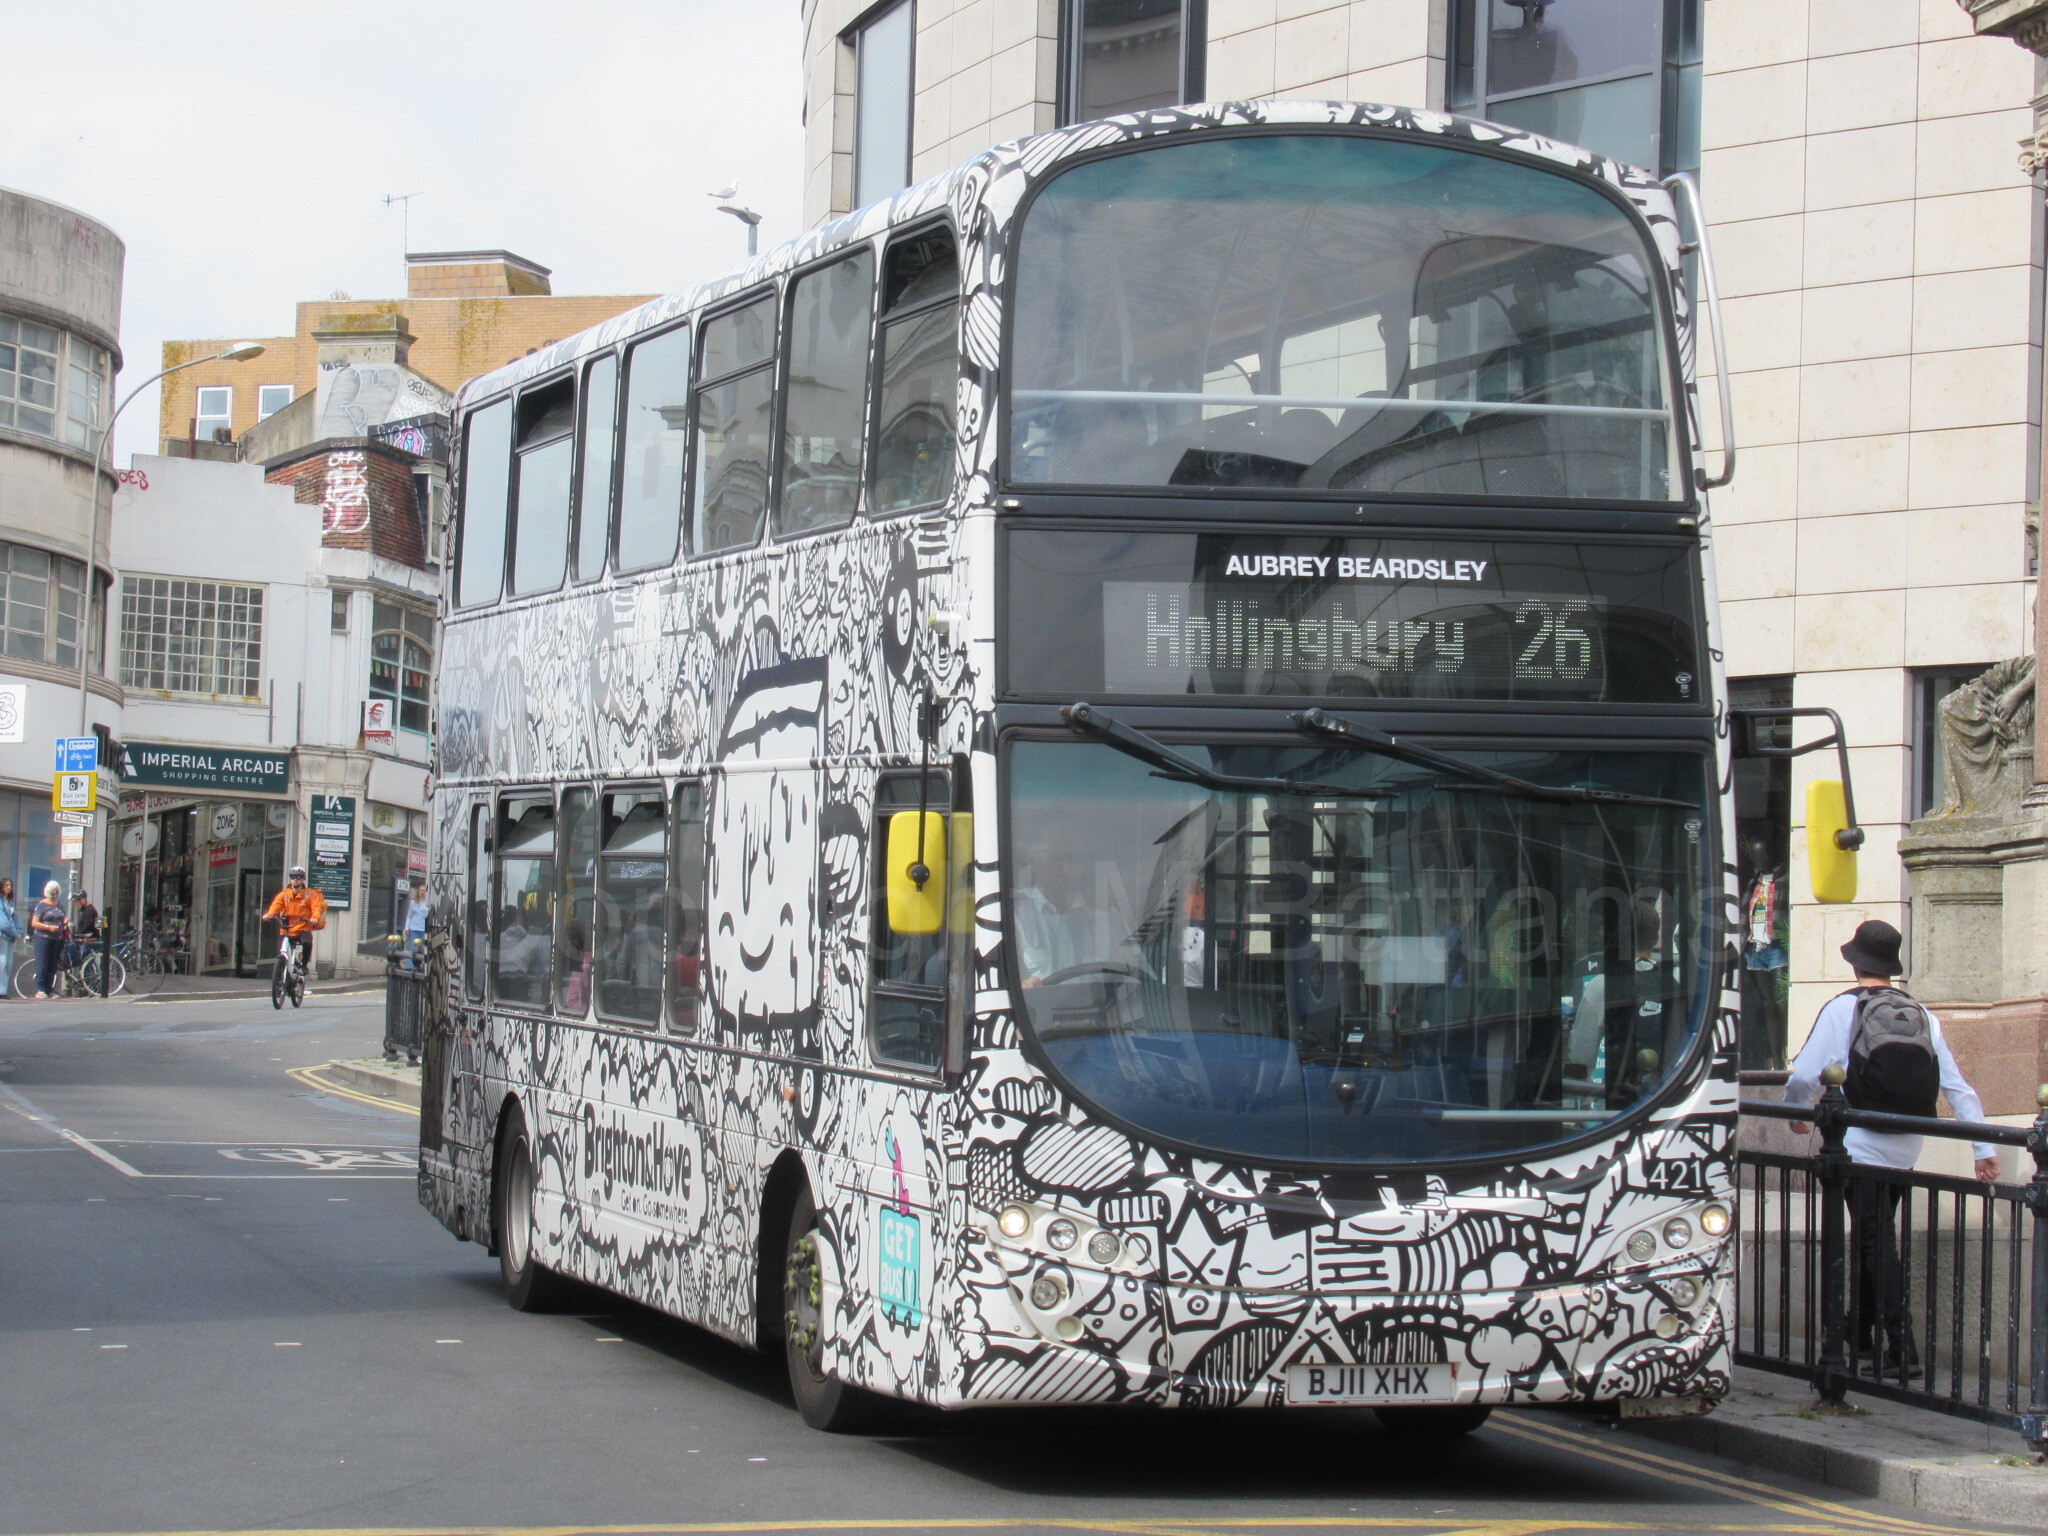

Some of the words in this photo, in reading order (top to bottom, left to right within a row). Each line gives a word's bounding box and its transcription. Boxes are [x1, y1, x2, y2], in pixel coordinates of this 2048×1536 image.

[1225, 554, 1332, 578] AUBREY
[1337, 556, 1487, 582] BEARDSLEY
[1146, 594, 1465, 672] Hollingbury
[1514, 598, 1592, 679] 26
[142, 751, 217, 771] IMPERIAL
[221, 757, 285, 775] ARCADE
[162, 770, 217, 782] SHOPPING
[222, 774, 265, 785] CENTRE
[216, 813, 235, 831] ZONE
[313, 809, 335, 817] IMPERIAL
[398, 880, 409, 891] ATM
[1649, 1160, 1703, 1190] 421
[621, 1188, 632, 1212] Get
[643, 1193, 652, 1216] Go
[884, 1217, 916, 1264] GET
[1308, 1367, 1366, 1396] BJ11
[1374, 1366, 1430, 1395] XHX
